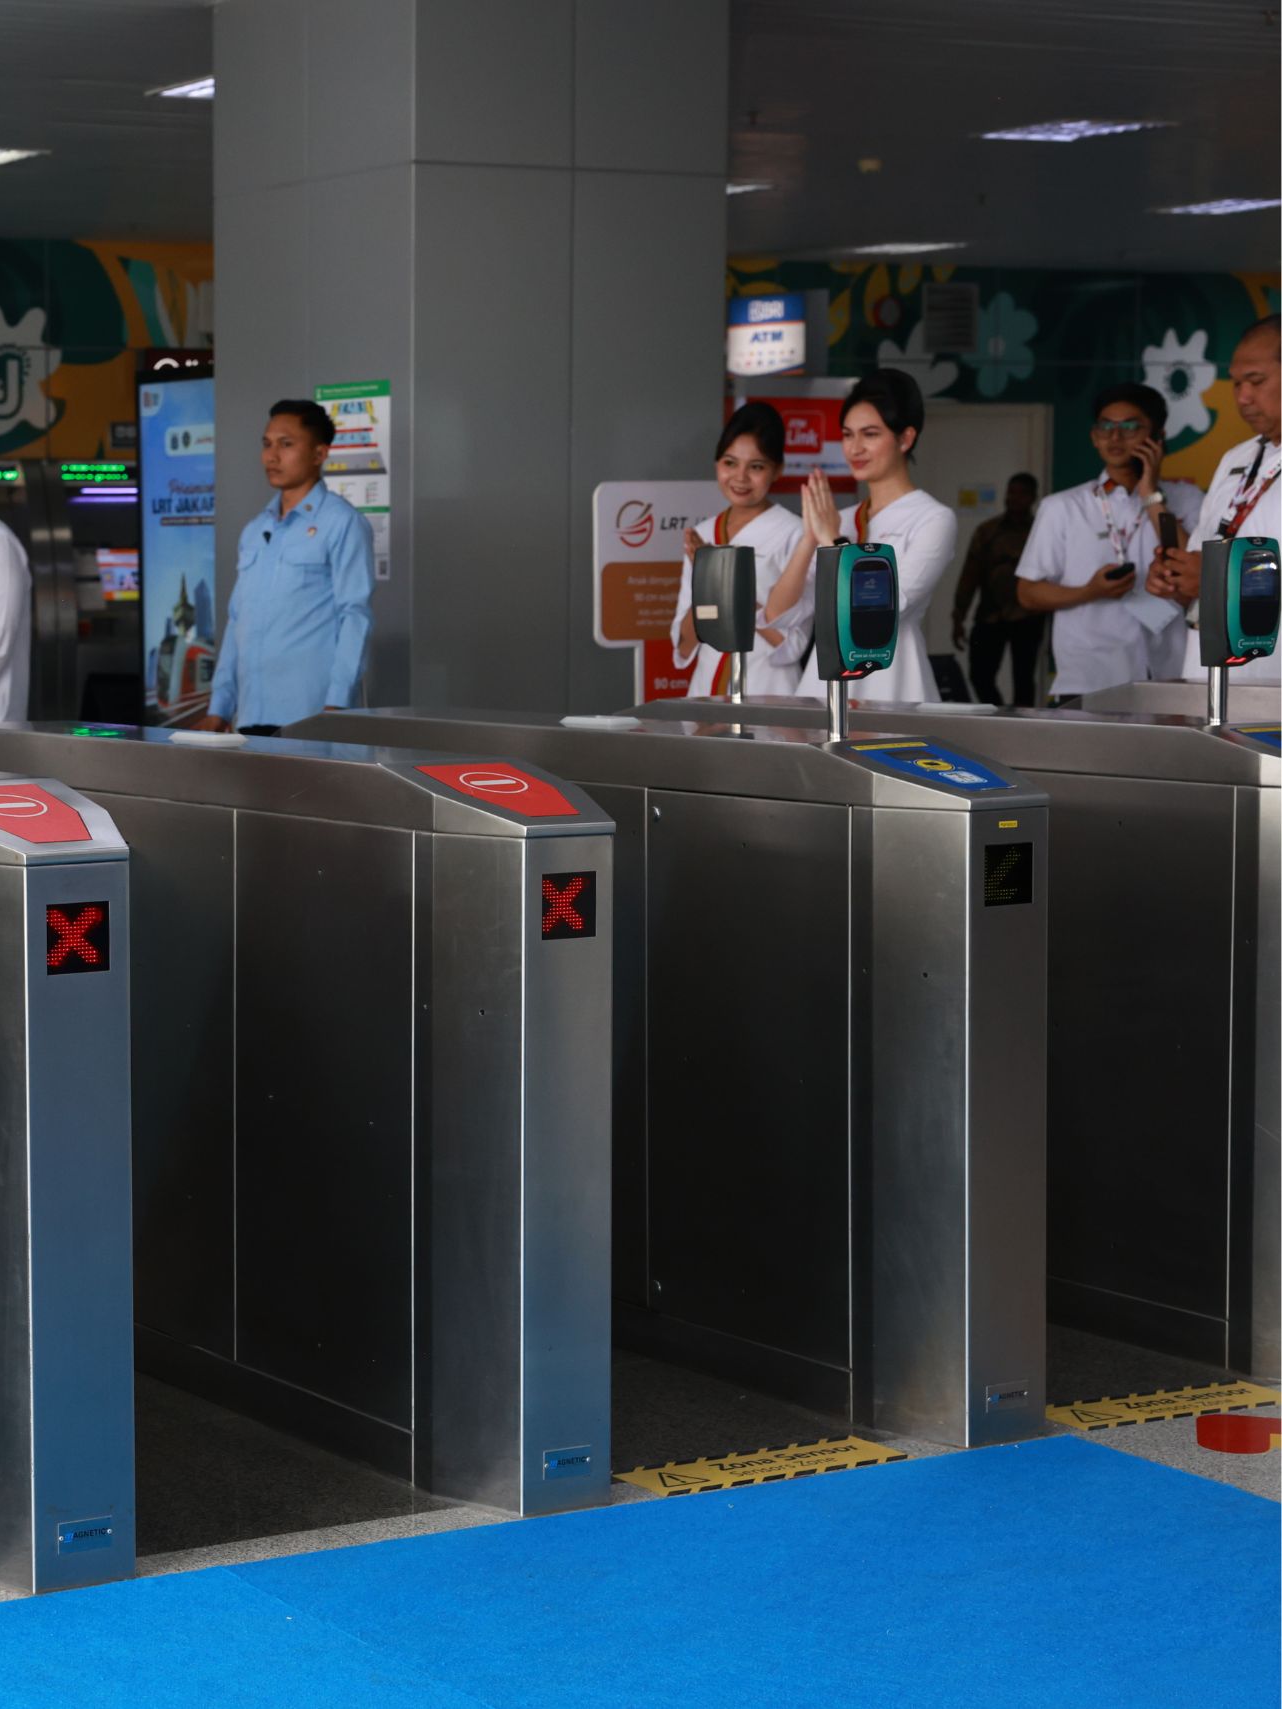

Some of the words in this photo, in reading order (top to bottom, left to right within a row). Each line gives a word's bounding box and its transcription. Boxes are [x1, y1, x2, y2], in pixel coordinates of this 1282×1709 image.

[750, 329, 783, 344] ATM
[785, 430, 818, 448] Link
[660, 517, 687, 531] LRT
[653, 677, 667, 690] 90
[1115, 1395, 1174, 1410] Zona
[1175, 1388, 1252, 1402] Sensor
[708, 1457, 773, 1472] Zona
[774, 1444, 858, 1462] Sensor
[729, 1462, 796, 1478] Sensors
[797, 1456, 838, 1469] Zone
